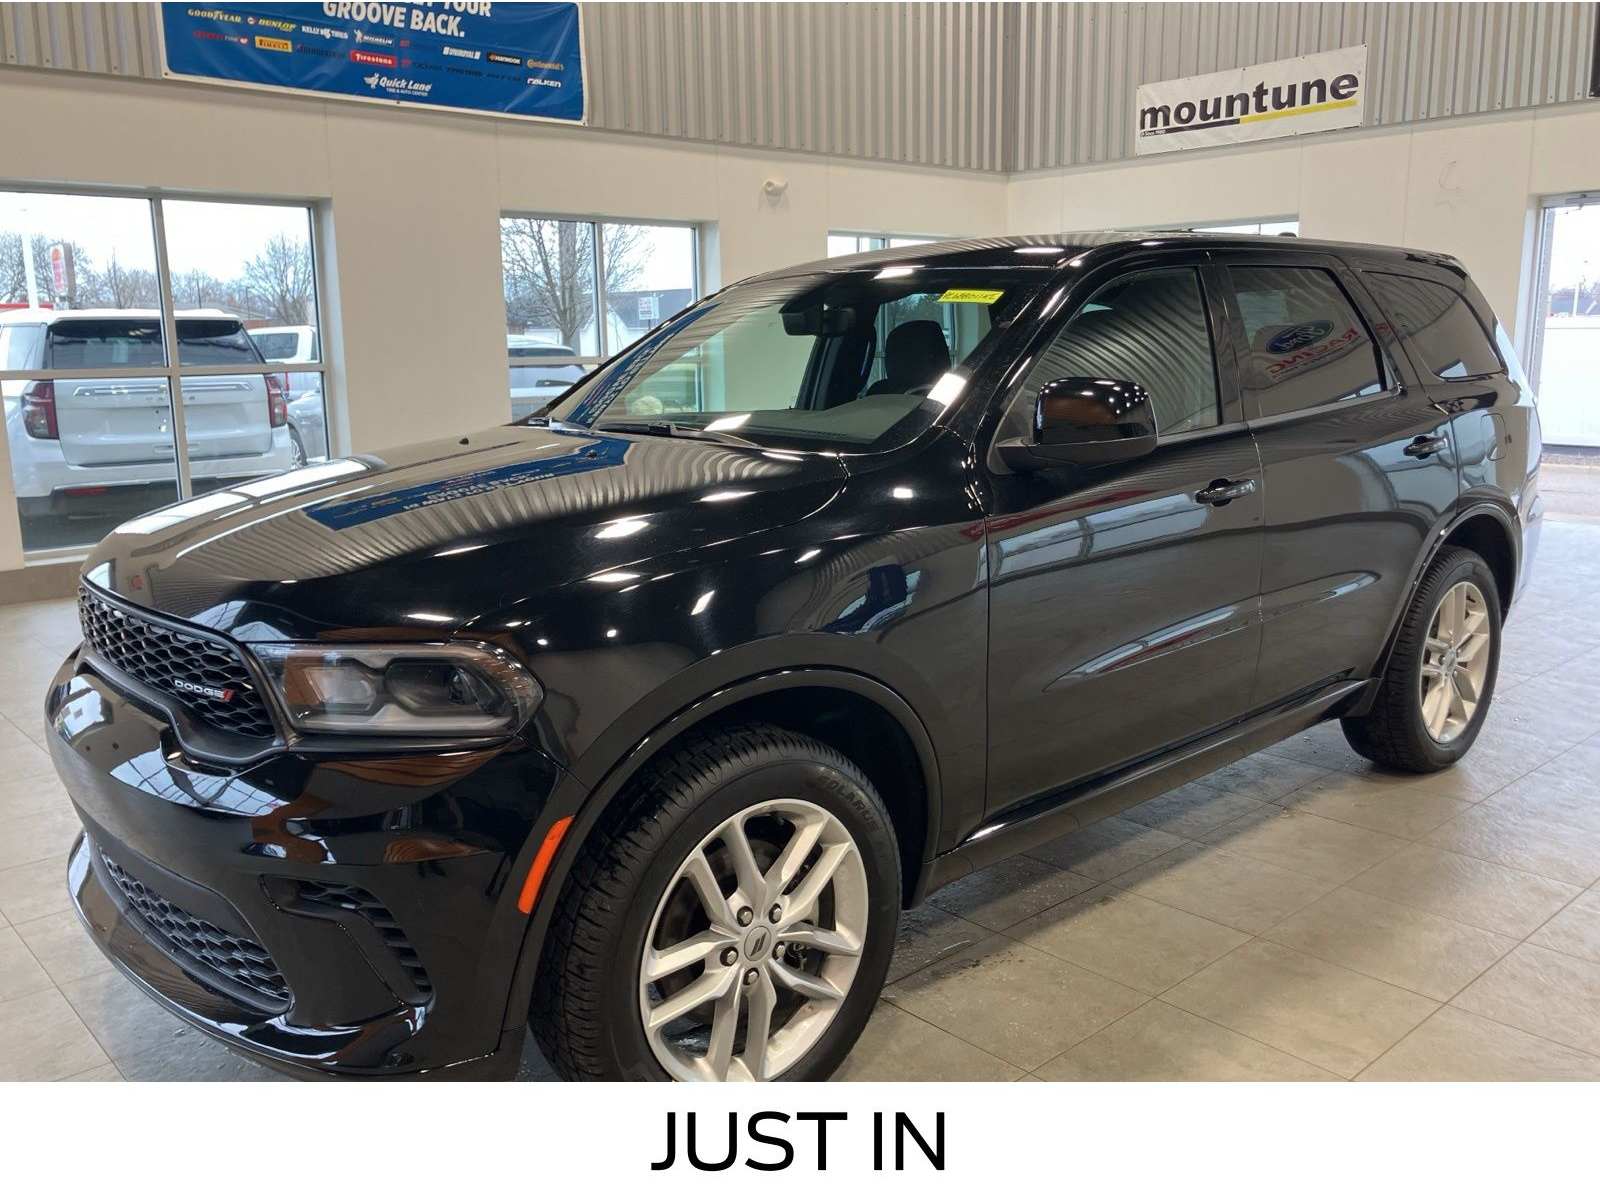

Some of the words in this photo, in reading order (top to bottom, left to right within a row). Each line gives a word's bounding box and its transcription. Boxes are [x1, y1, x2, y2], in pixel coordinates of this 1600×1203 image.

[188, 8, 242, 23] GOODYEAR
[323, 2, 407, 28] GROOVE
[410, 9, 465, 38] BACK.
[258, 18, 296, 32] DUNLOP
[355, 53, 393, 65] Firestone
[379, 76, 407, 89] Quick
[407, 80, 432, 92] Lane
[1139, 72, 1359, 130] mountune
[174, 679, 225, 699] DODGE
